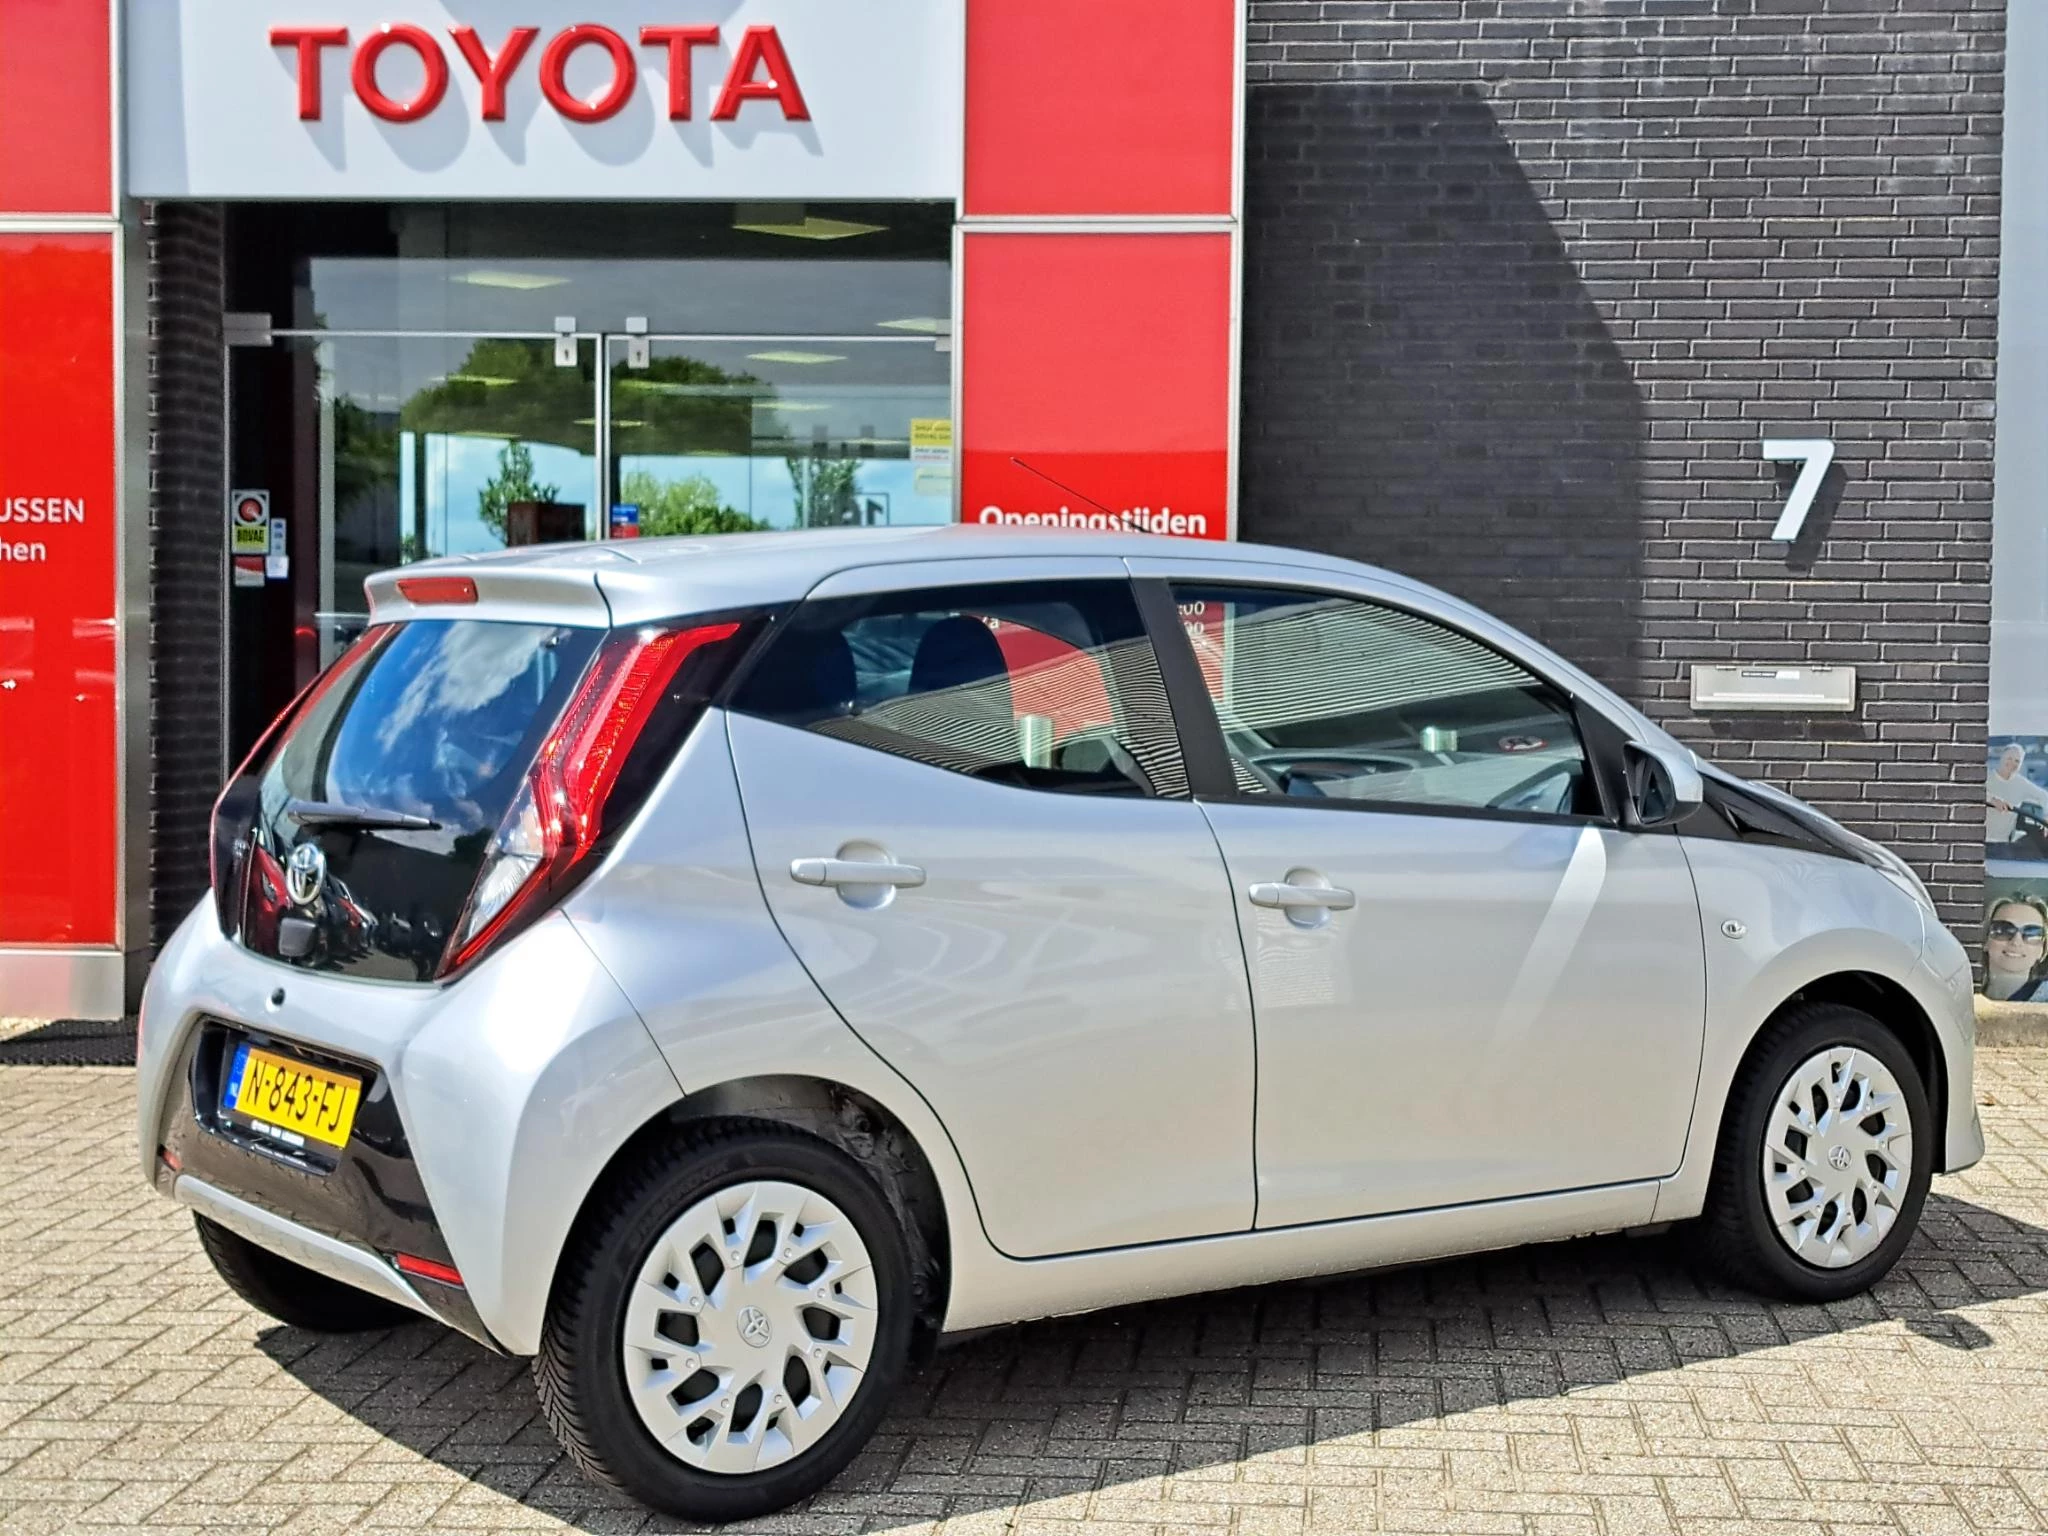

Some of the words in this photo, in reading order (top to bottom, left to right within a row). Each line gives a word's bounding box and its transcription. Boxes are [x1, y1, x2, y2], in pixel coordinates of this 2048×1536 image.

[269, 23, 812, 124] TOYOTA
[1762, 438, 1835, 541] 7
[246, 1058, 348, 1132] N-843-FJ
